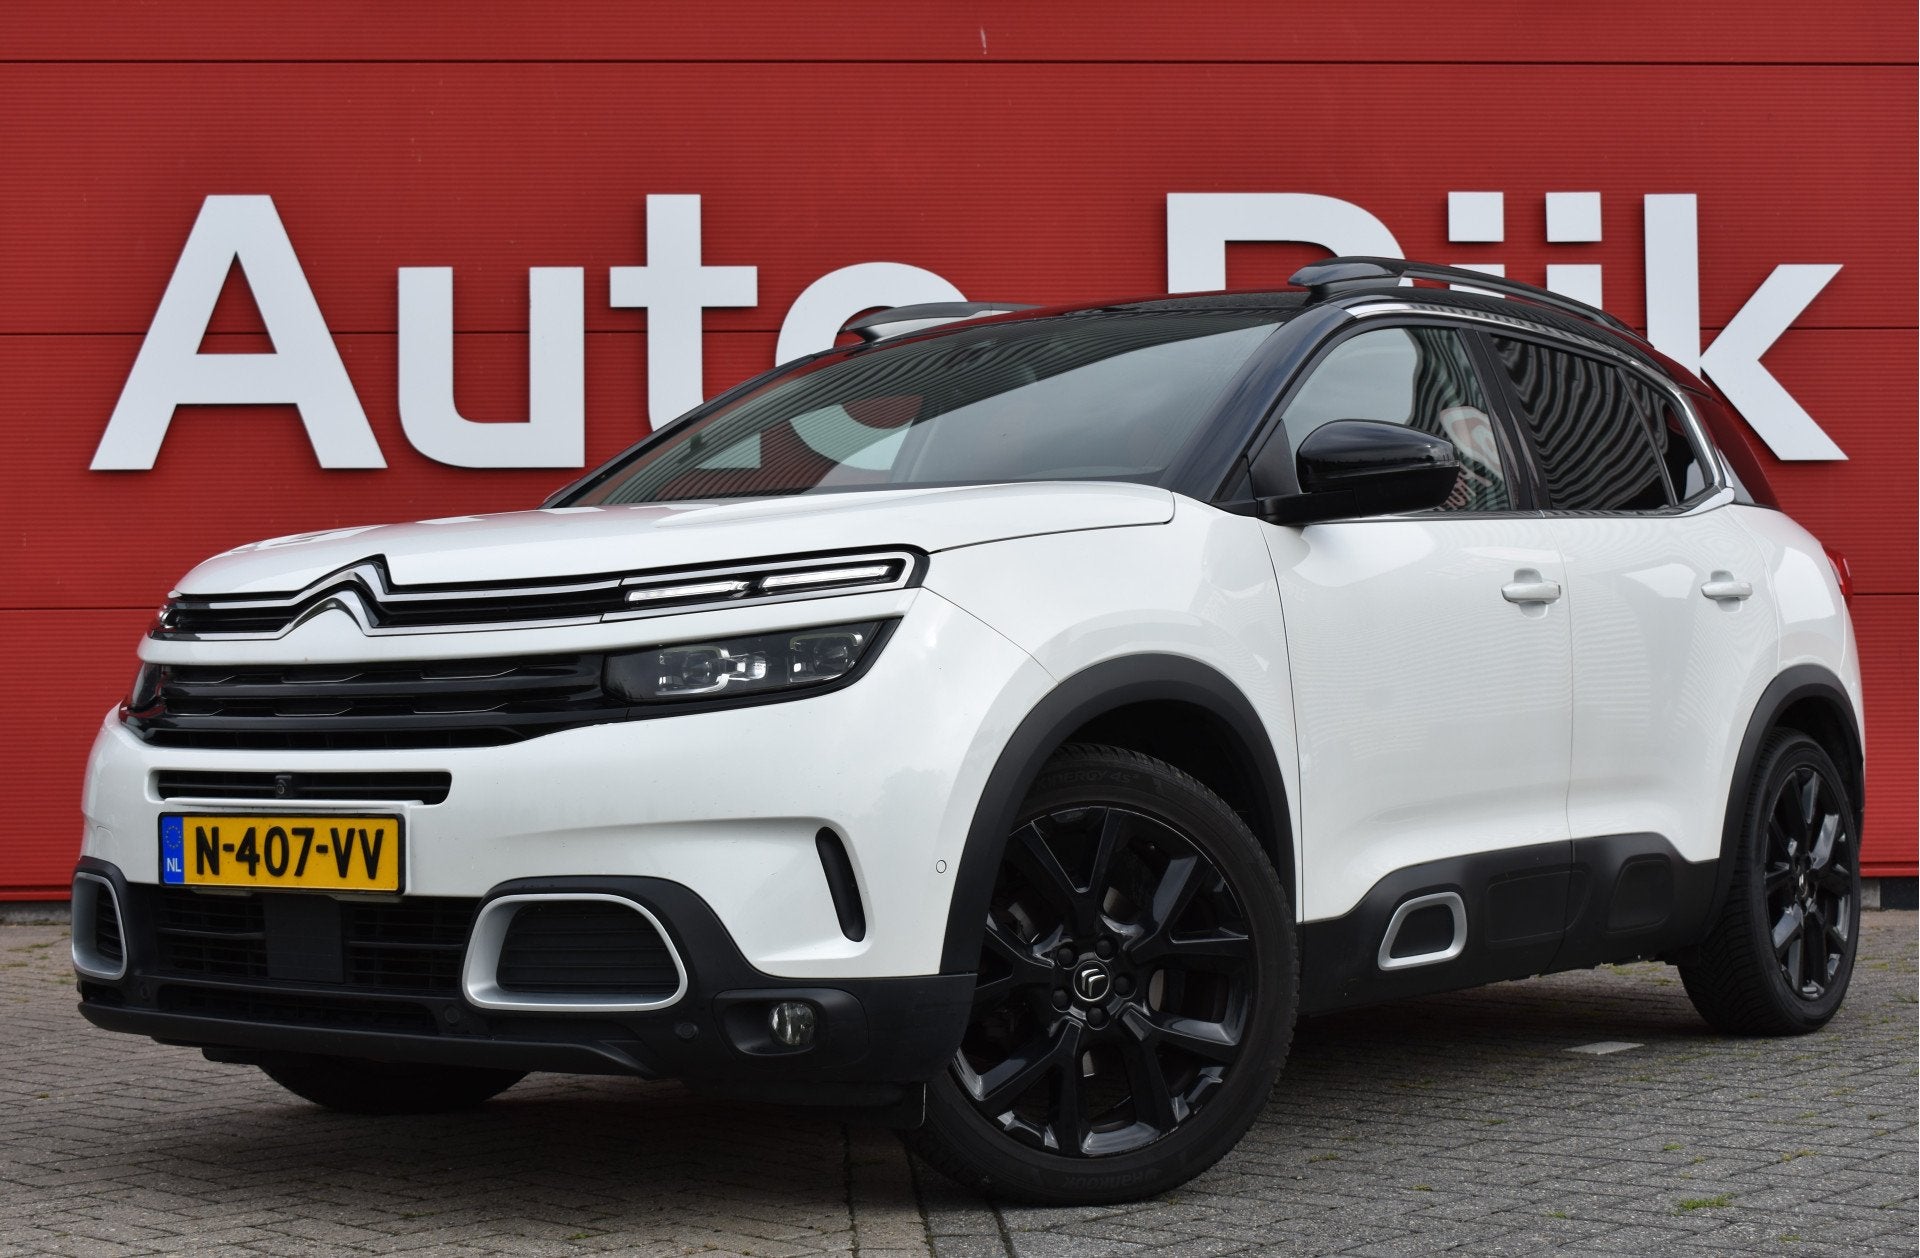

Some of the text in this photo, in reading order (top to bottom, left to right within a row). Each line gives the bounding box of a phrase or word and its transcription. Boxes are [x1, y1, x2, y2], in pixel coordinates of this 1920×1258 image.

[89, 193, 970, 471] Auto
[166, 857, 182, 873] NL
[195, 825, 385, 880] N-407-VV
